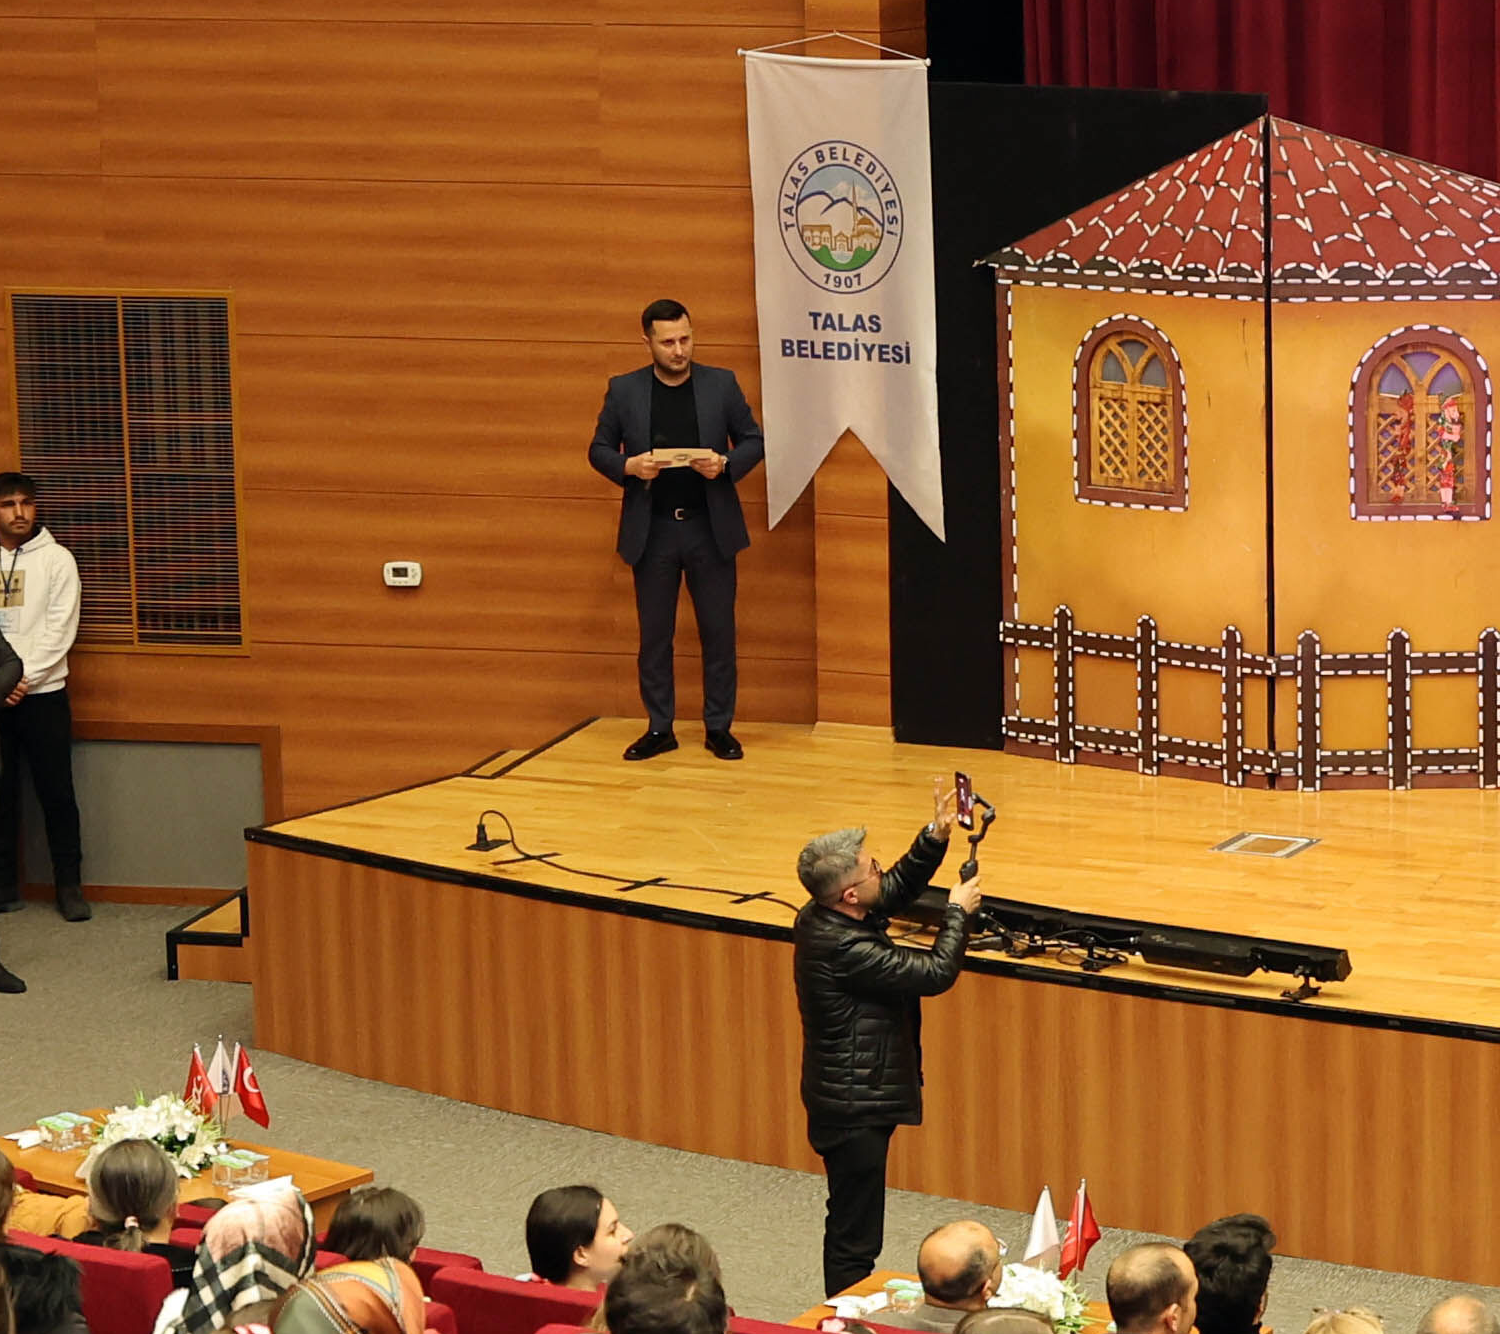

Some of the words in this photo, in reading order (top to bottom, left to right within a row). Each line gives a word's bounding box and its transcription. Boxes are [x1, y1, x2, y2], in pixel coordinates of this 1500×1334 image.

[783, 162, 809, 232] TALAS
[823, 273, 862, 288] 1907
[808, 311, 882, 333] TALAS
[781, 338, 911, 365] BELEDİYESİ
